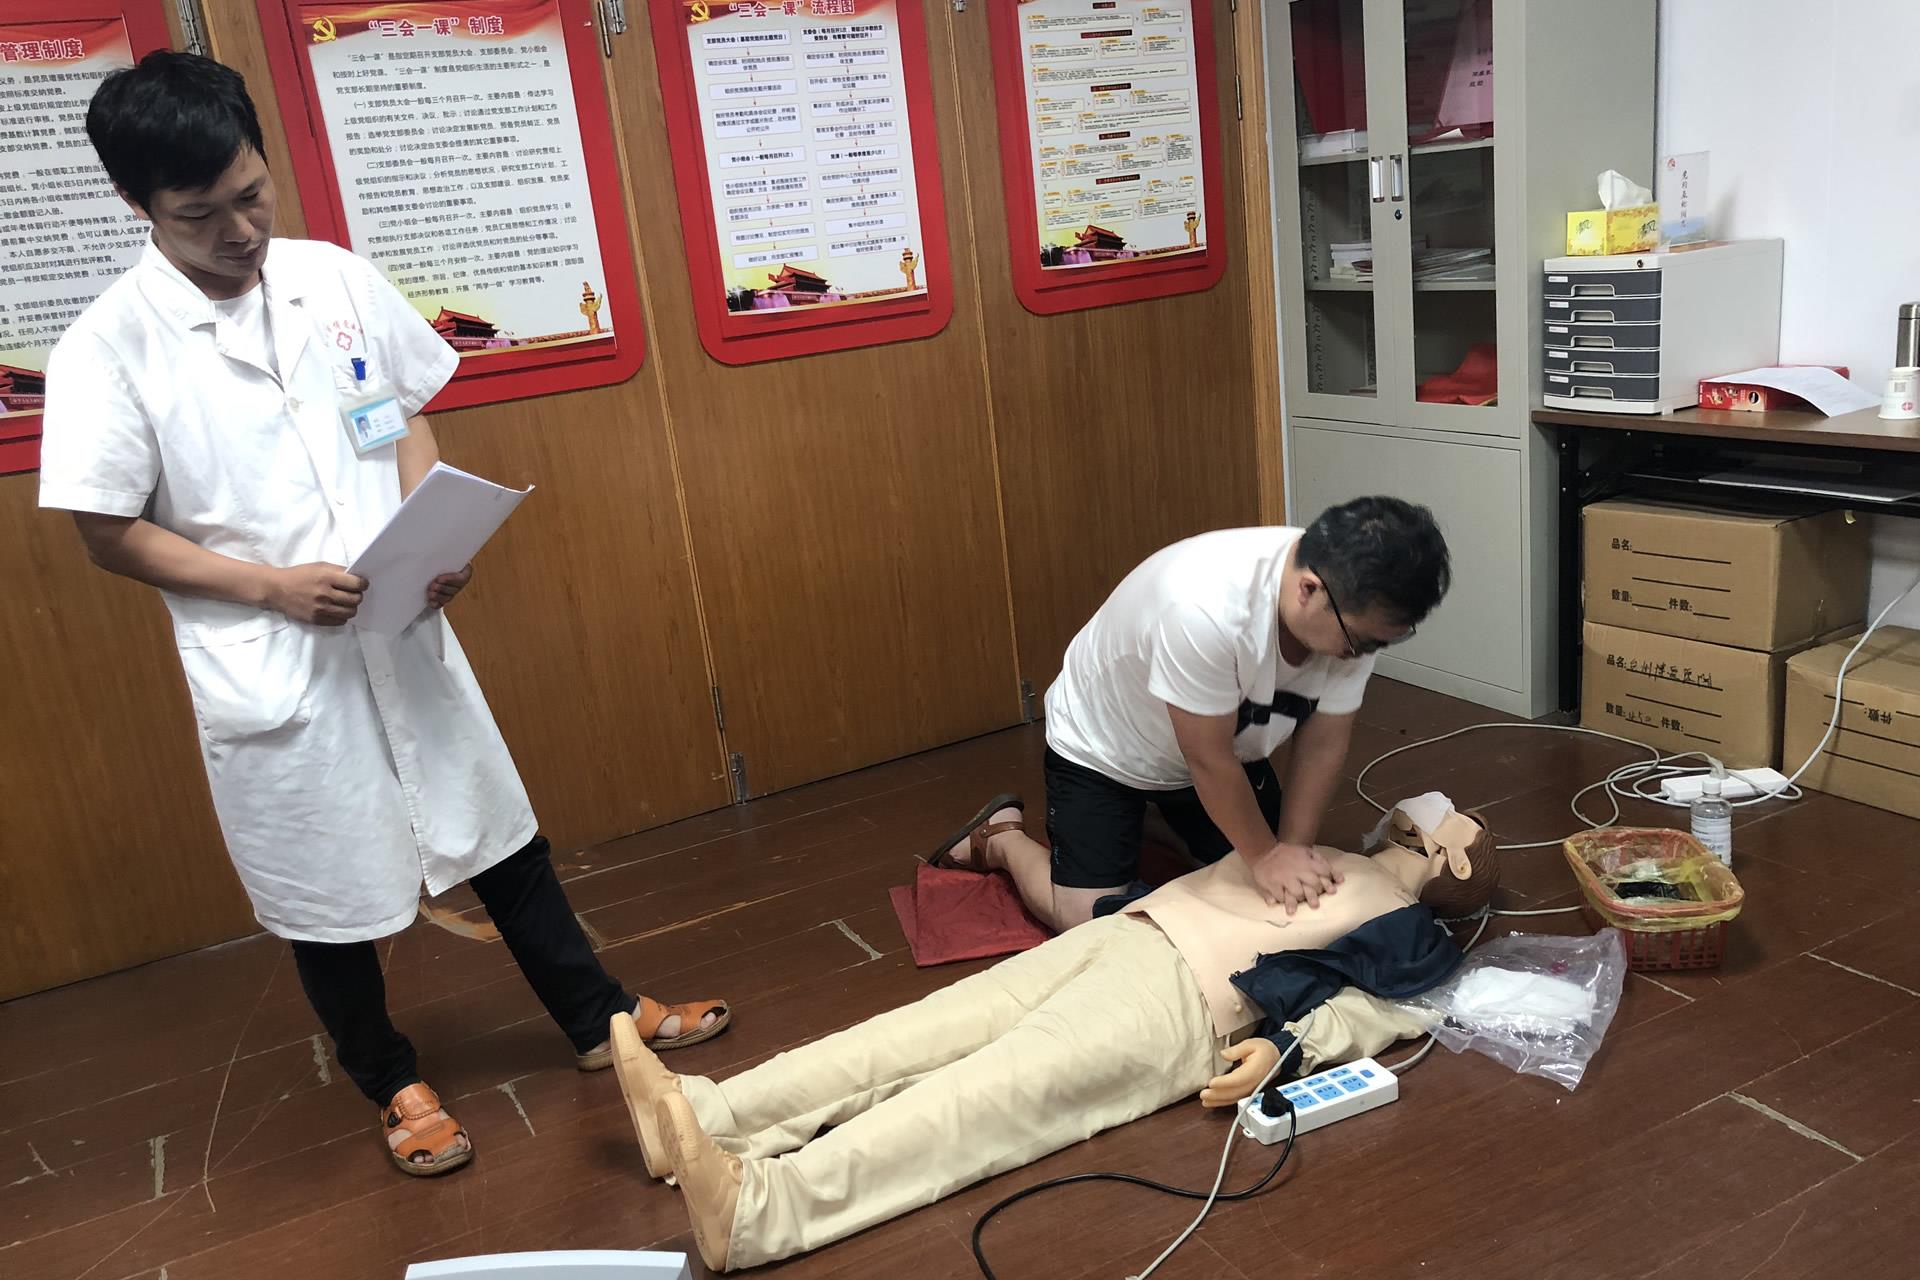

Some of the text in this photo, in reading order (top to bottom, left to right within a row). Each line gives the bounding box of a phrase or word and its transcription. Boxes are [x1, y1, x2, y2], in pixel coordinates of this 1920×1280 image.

[368, 16, 504, 38] “三会一课”制度
[0, 39, 84, 62] 管理制度
[0, 140, 93, 153] 支部交纳党费。党员的正
